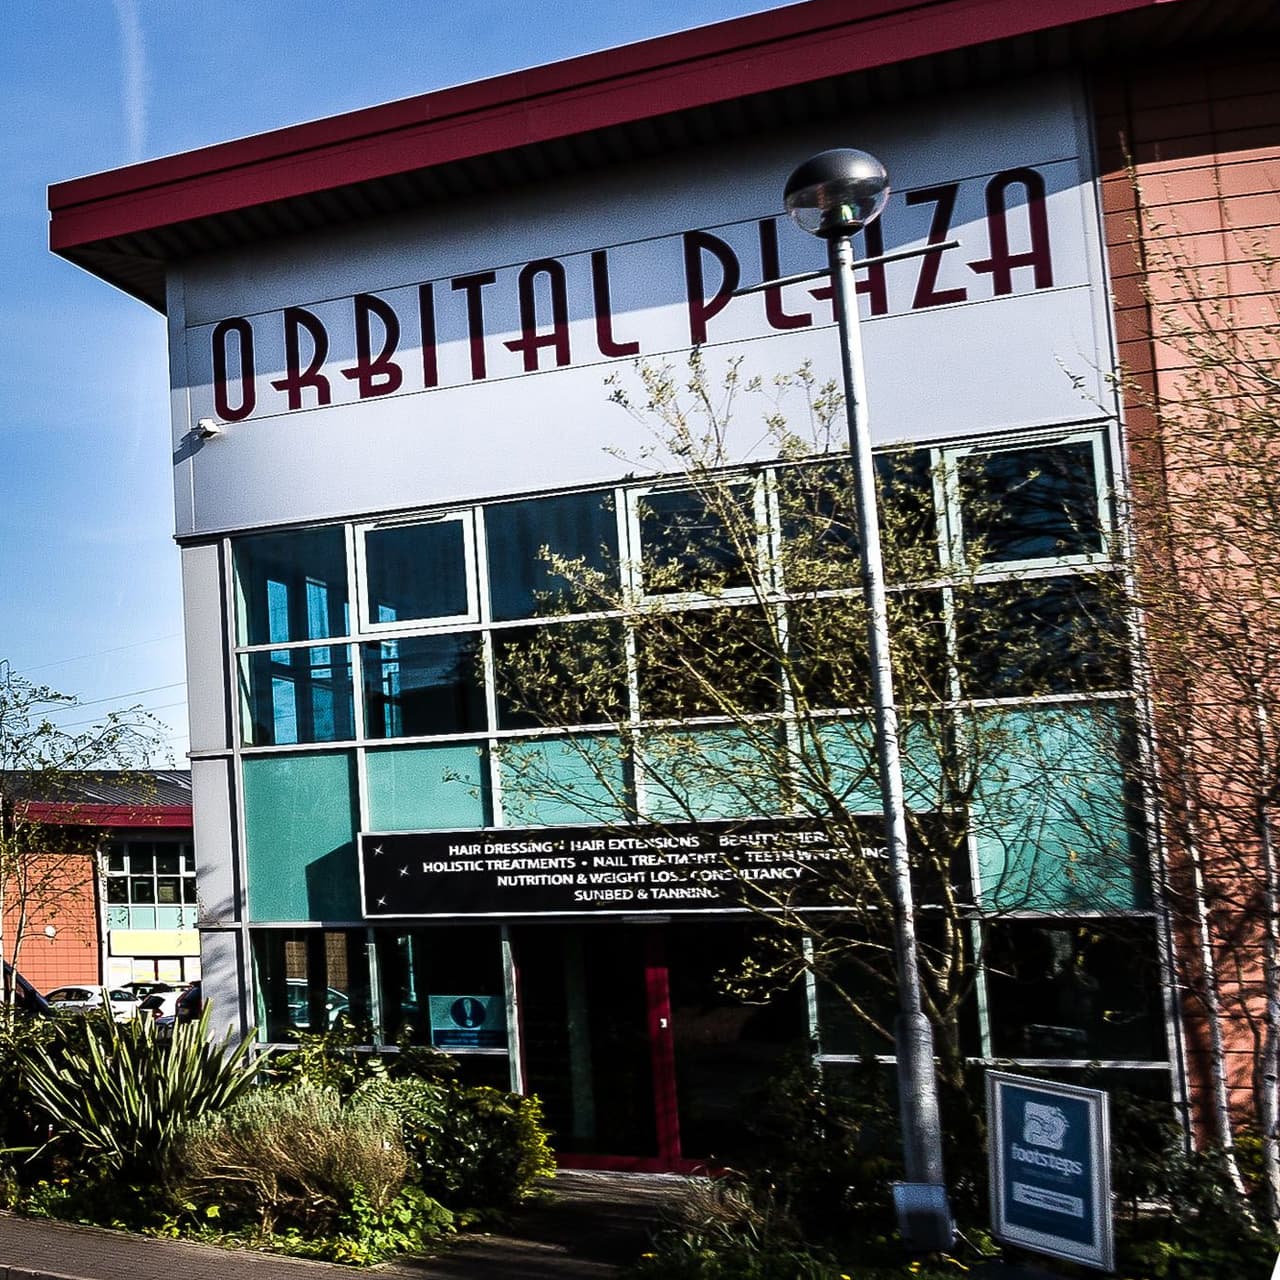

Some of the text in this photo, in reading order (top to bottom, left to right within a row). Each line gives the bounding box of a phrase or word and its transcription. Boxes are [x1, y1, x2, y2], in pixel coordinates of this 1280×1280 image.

[211, 166, 1054, 422] ORBITAL PLAZA
[448, 844, 482, 857] HAIR
[484, 841, 553, 855] DRESSING
[570, 839, 605, 852] HAIR
[423, 860, 483, 873] HOLISTIC
[483, 856, 577, 871] TREATMENTS
[592, 856, 628, 868] NAIL
[497, 873, 574, 887] NUTRITION
[589, 871, 647, 885] WEIGHT
[574, 888, 634, 902] SUNBED
[1011, 1141, 1084, 1177] footsteps
